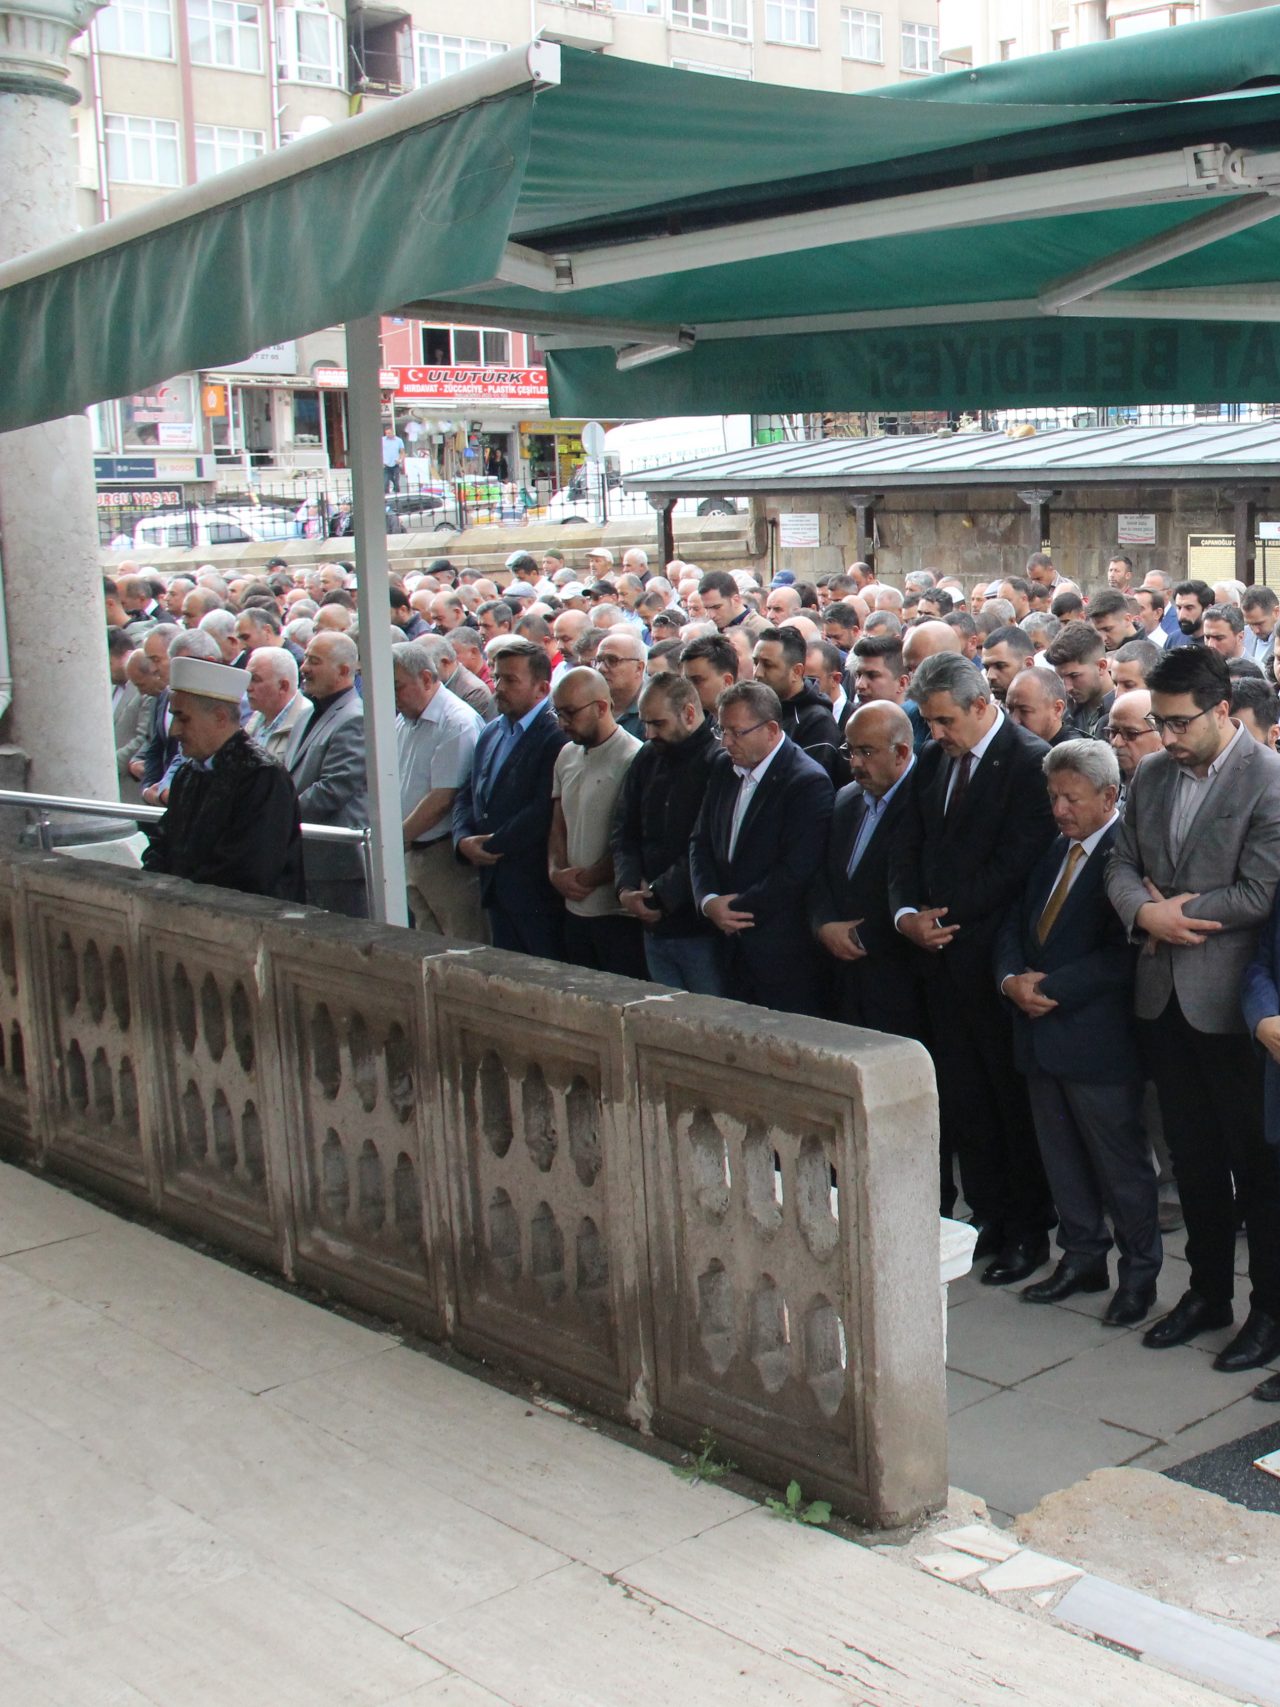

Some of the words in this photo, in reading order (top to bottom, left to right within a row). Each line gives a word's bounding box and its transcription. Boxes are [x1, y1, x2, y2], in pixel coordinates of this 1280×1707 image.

[428, 369, 524, 384] ULUTÜRK
[404, 384, 438, 393] HIRDAVAT
[444, 383, 483, 394] ZÜCCACİYE
[488, 383, 516, 395] PLASTİK
[97, 492, 132, 507] URCU
[132, 491, 180, 508] YAŞAR
